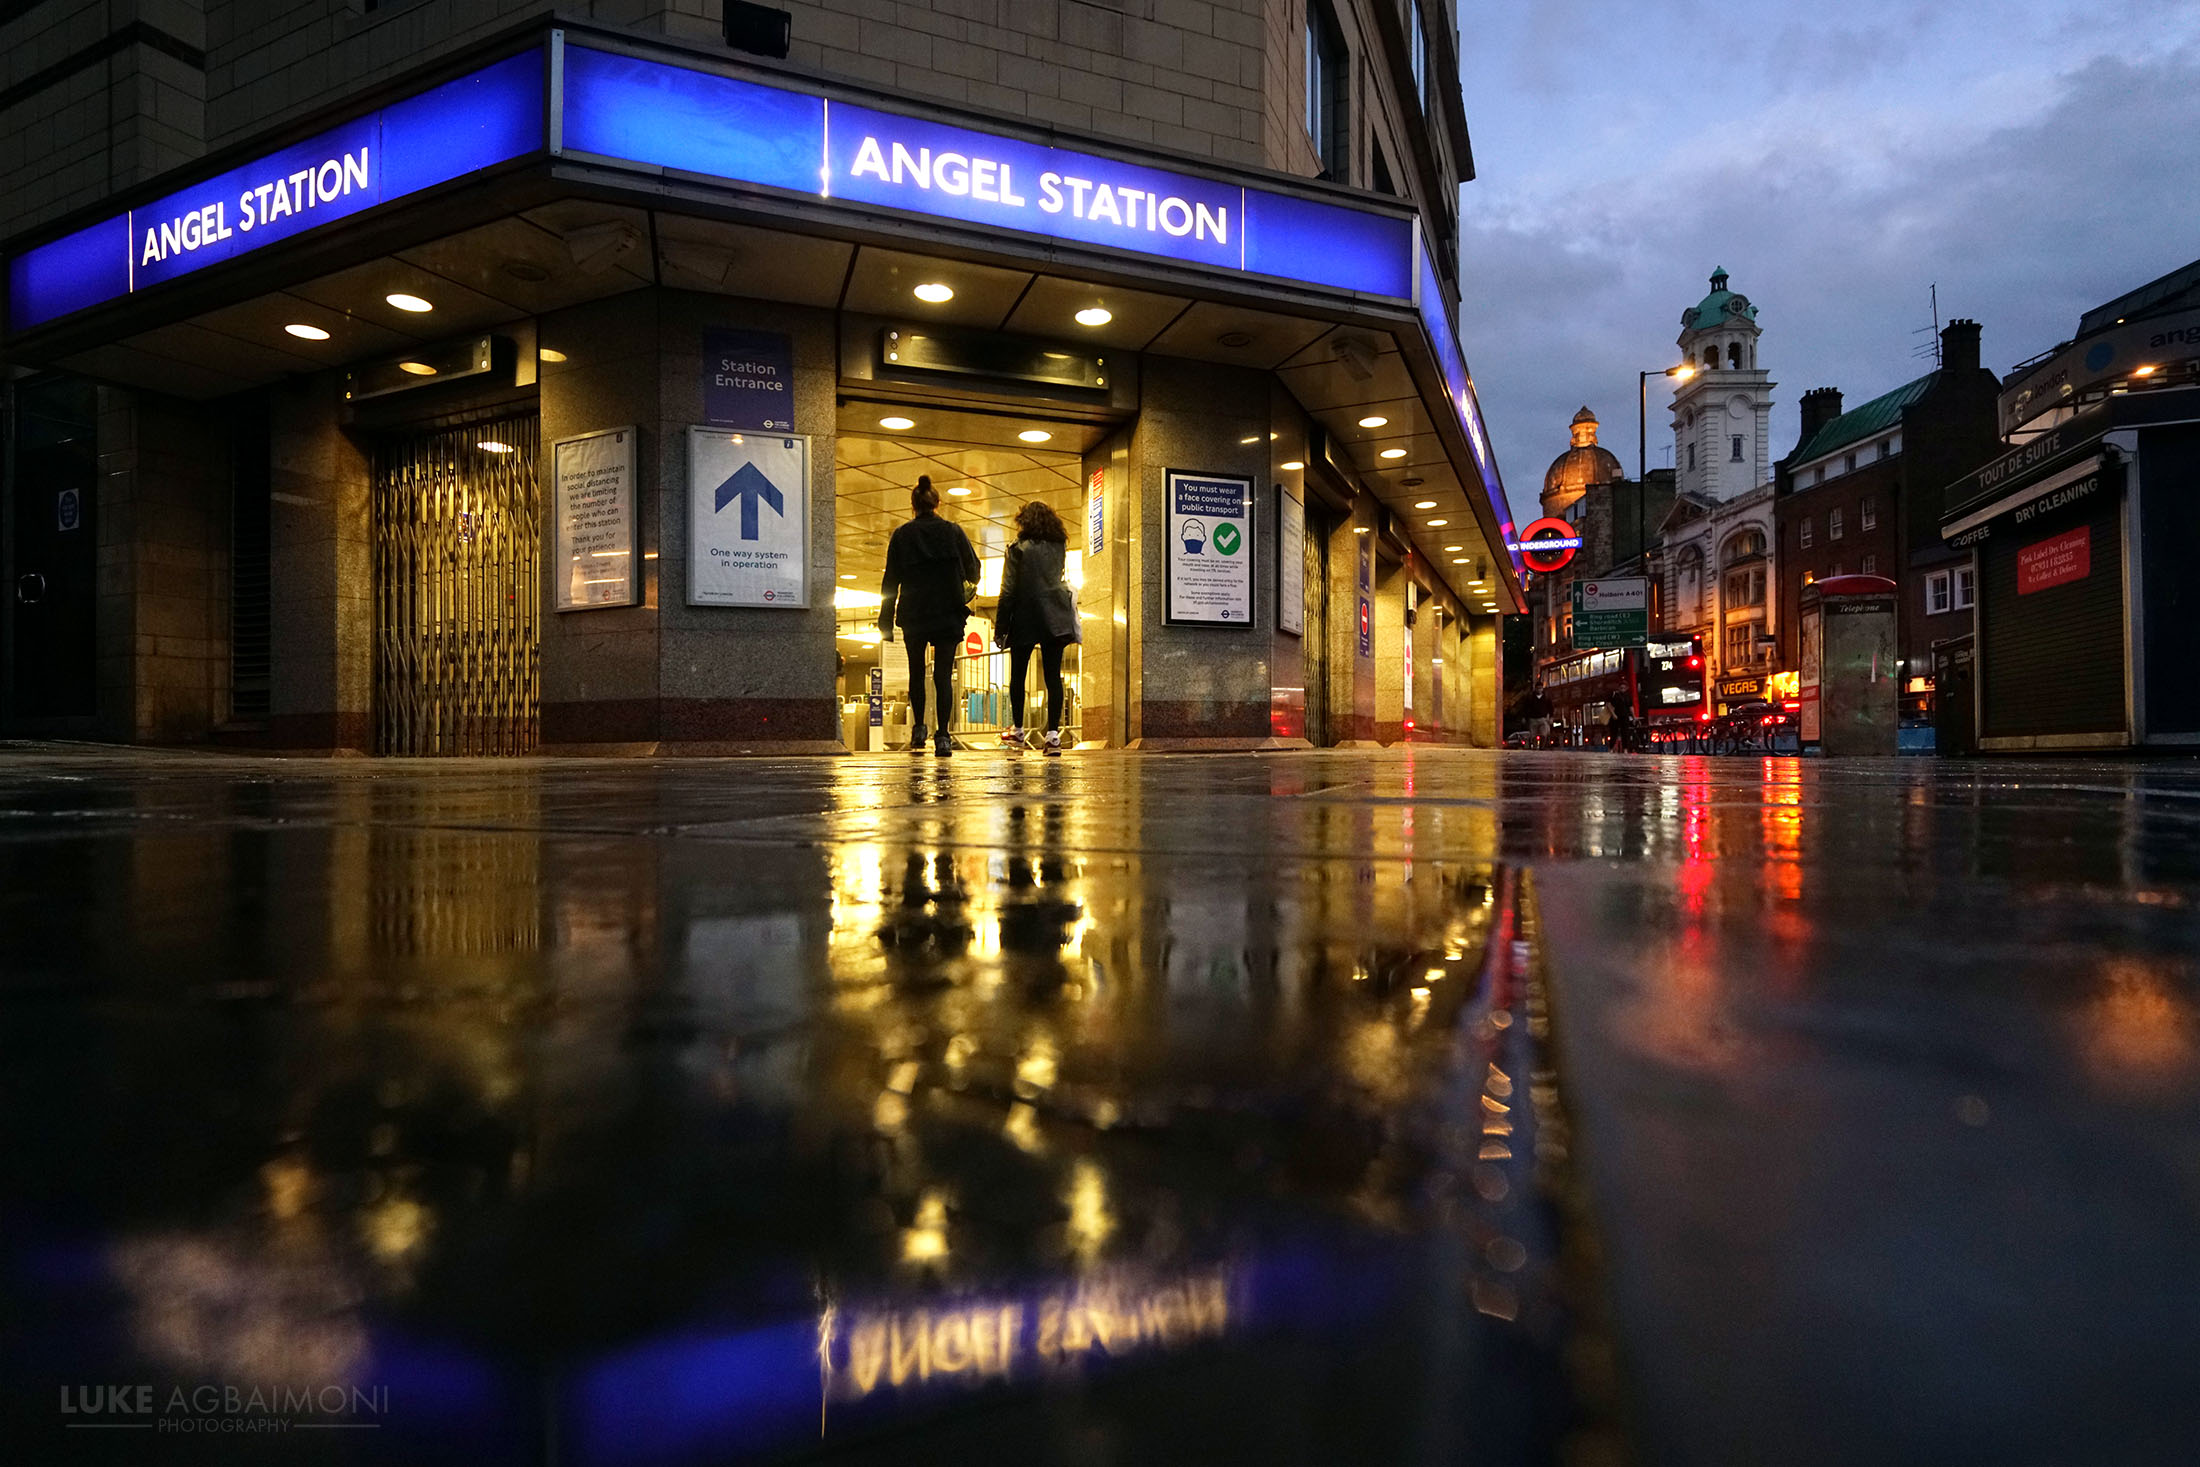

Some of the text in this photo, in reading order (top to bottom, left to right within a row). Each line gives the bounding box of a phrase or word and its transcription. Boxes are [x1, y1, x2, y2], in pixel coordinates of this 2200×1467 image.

[850, 136, 1227, 245] ANGEL STATION
[141, 147, 369, 266] ANGEL STATION
[721, 359, 776, 375] Station
[716, 374, 783, 391] Entrance
[1979, 433, 2060, 488] TOUT DE SUITE
[561, 474, 568, 482] In
[569, 472, 586, 480] order
[596, 465, 625, 475] maintain
[567, 476, 620, 491] social distancing
[1183, 483, 1236, 495] You must wear
[592, 487, 617, 497] limiting
[582, 498, 607, 508] number
[608, 496, 616, 504] of
[1184, 493, 1200, 501] face
[1201, 495, 1231, 505] covering
[2015, 478, 2099, 524] DRY CLEANING
[1181, 504, 1239, 514] public transport
[584, 521, 597, 529] this
[598, 518, 621, 528] station
[571, 531, 616, 544] Thank you for
[1951, 526, 1991, 547] COFFEE
[587, 543, 616, 554] patience
[710, 548, 788, 560] One way system
[733, 560, 777, 569] operation
[1840, 604, 1880, 614] Telephone
[1722, 680, 1758, 695] VEGAS
